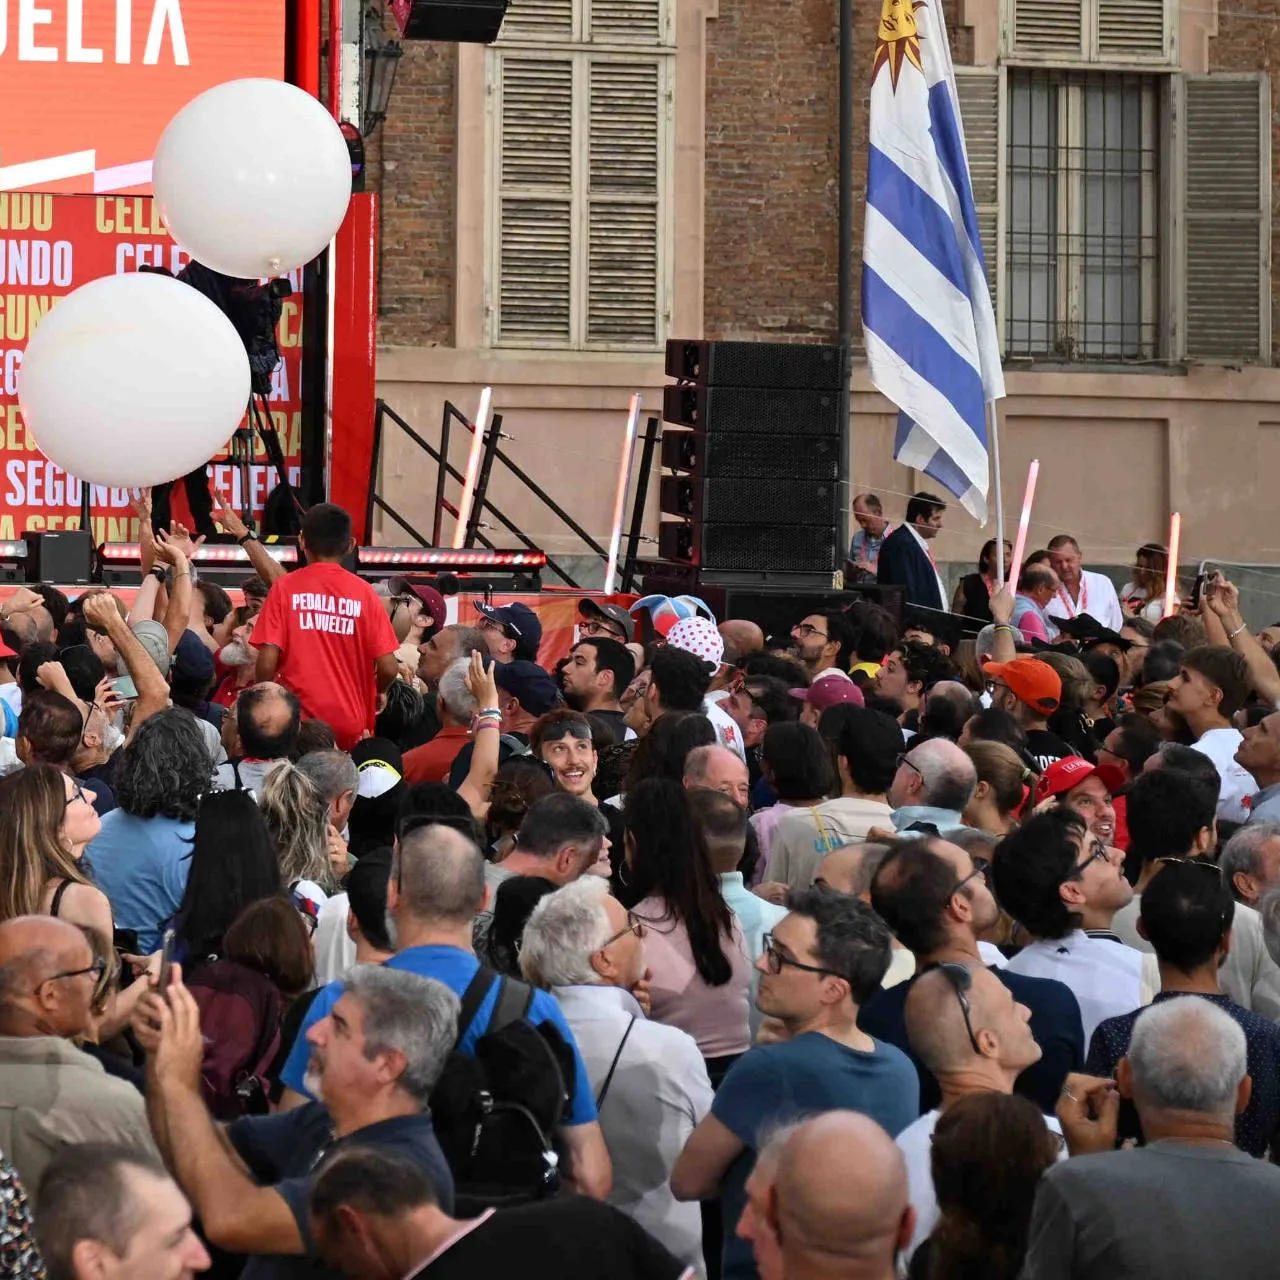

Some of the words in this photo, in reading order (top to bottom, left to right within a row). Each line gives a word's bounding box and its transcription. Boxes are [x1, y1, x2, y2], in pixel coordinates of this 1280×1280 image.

[292, 593, 335, 614] PEDALA
[338, 597, 362, 618] CON
[299, 612, 314, 630] LA
[314, 613, 354, 635] VUELTA
